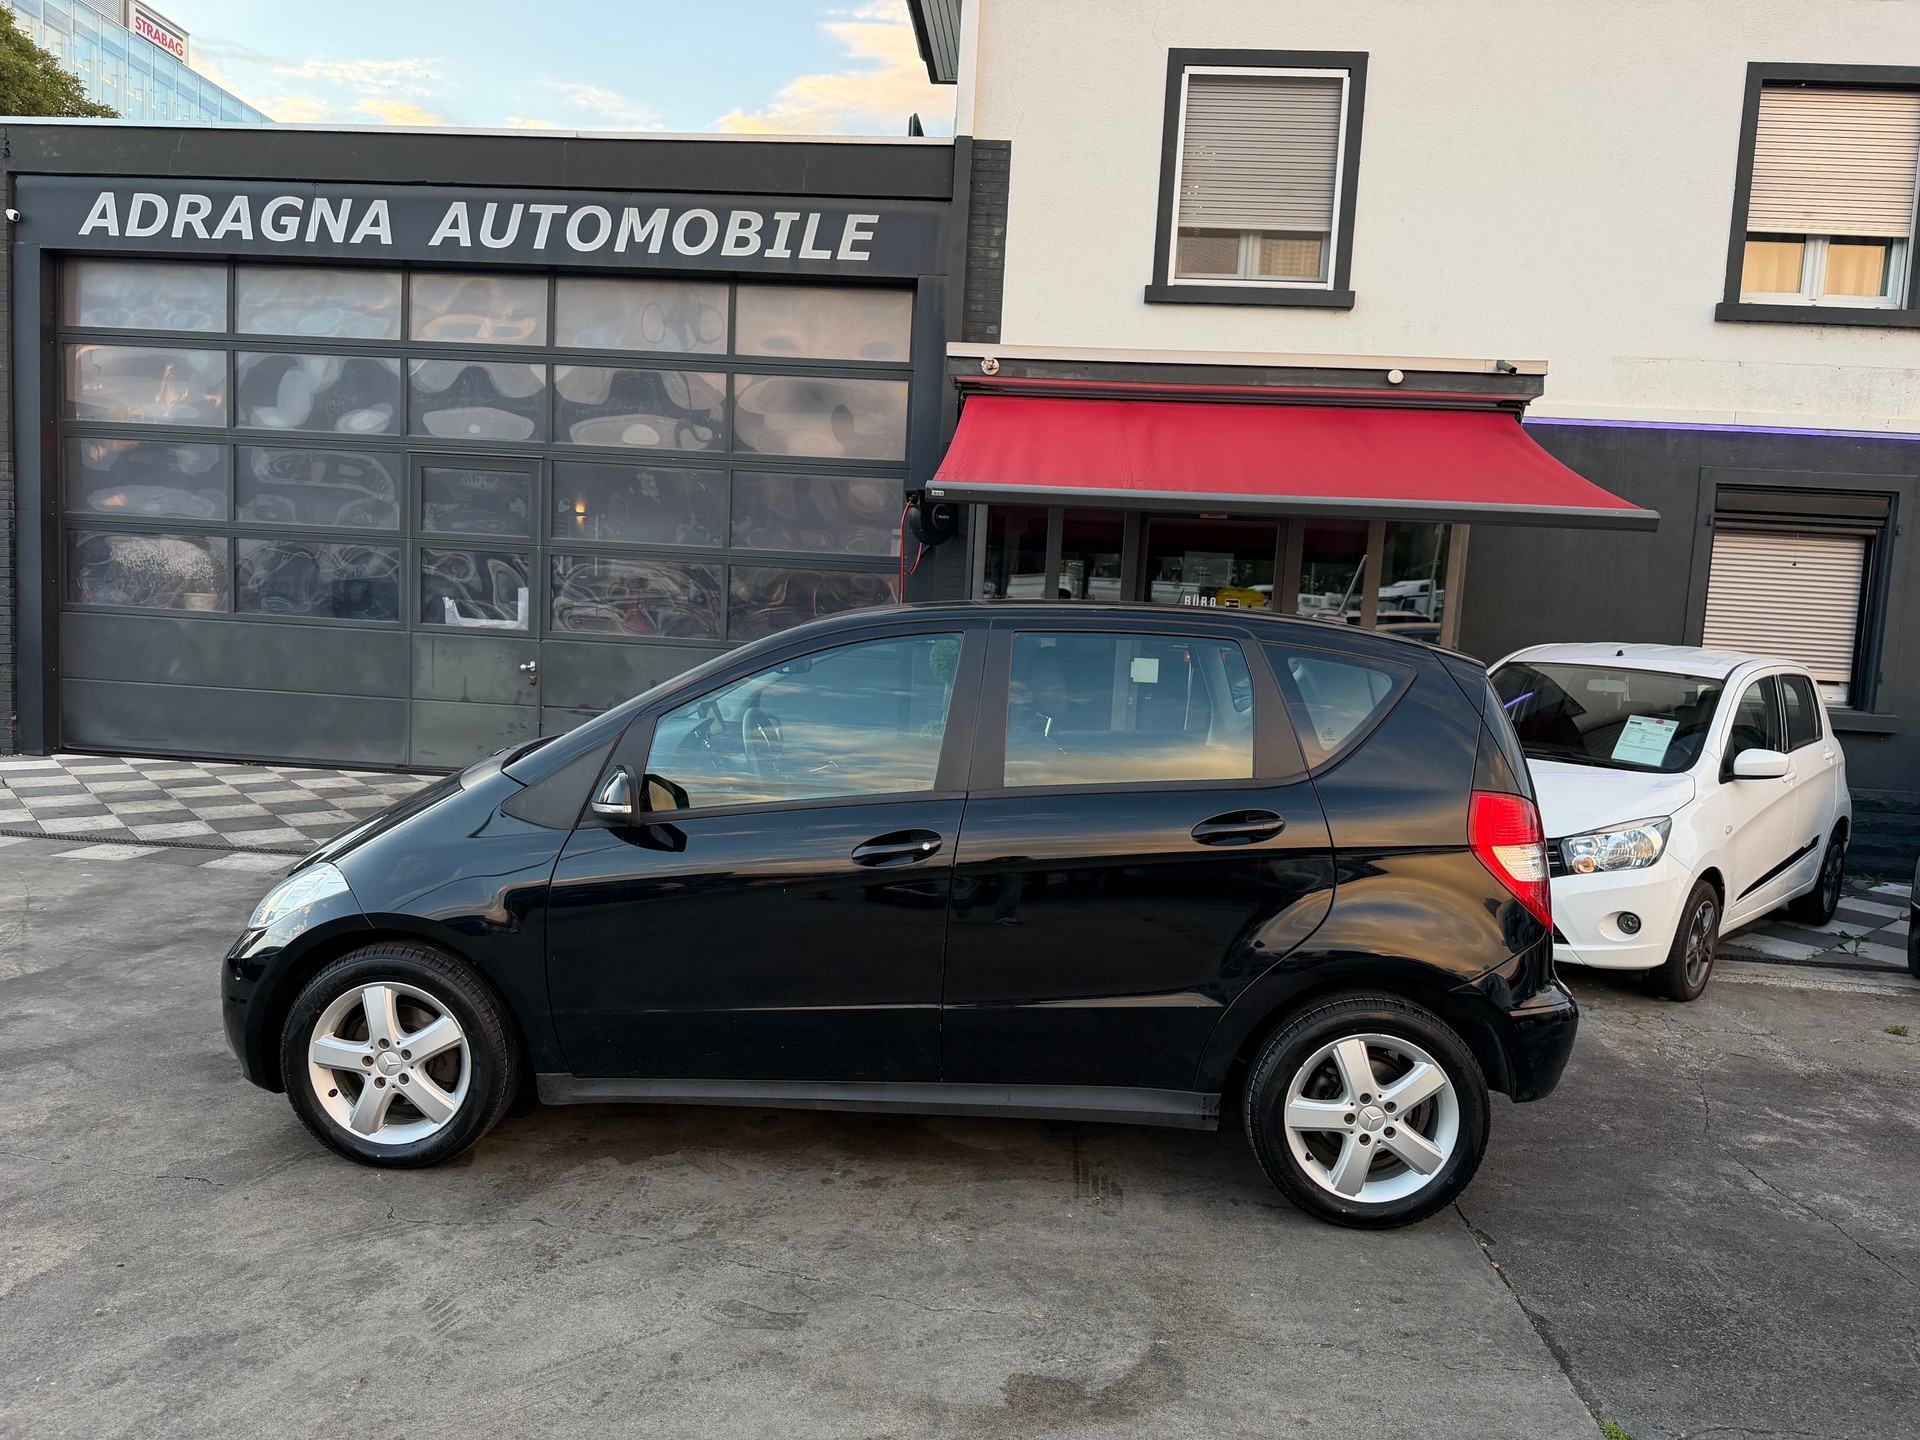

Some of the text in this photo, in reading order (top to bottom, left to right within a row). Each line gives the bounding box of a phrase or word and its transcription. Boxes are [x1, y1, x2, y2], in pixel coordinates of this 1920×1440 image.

[135, 16, 184, 57] STRABAG
[78, 191, 880, 261] ADRAGNA AUTOMOBILE
[1184, 594, 1217, 607] BÜRO
